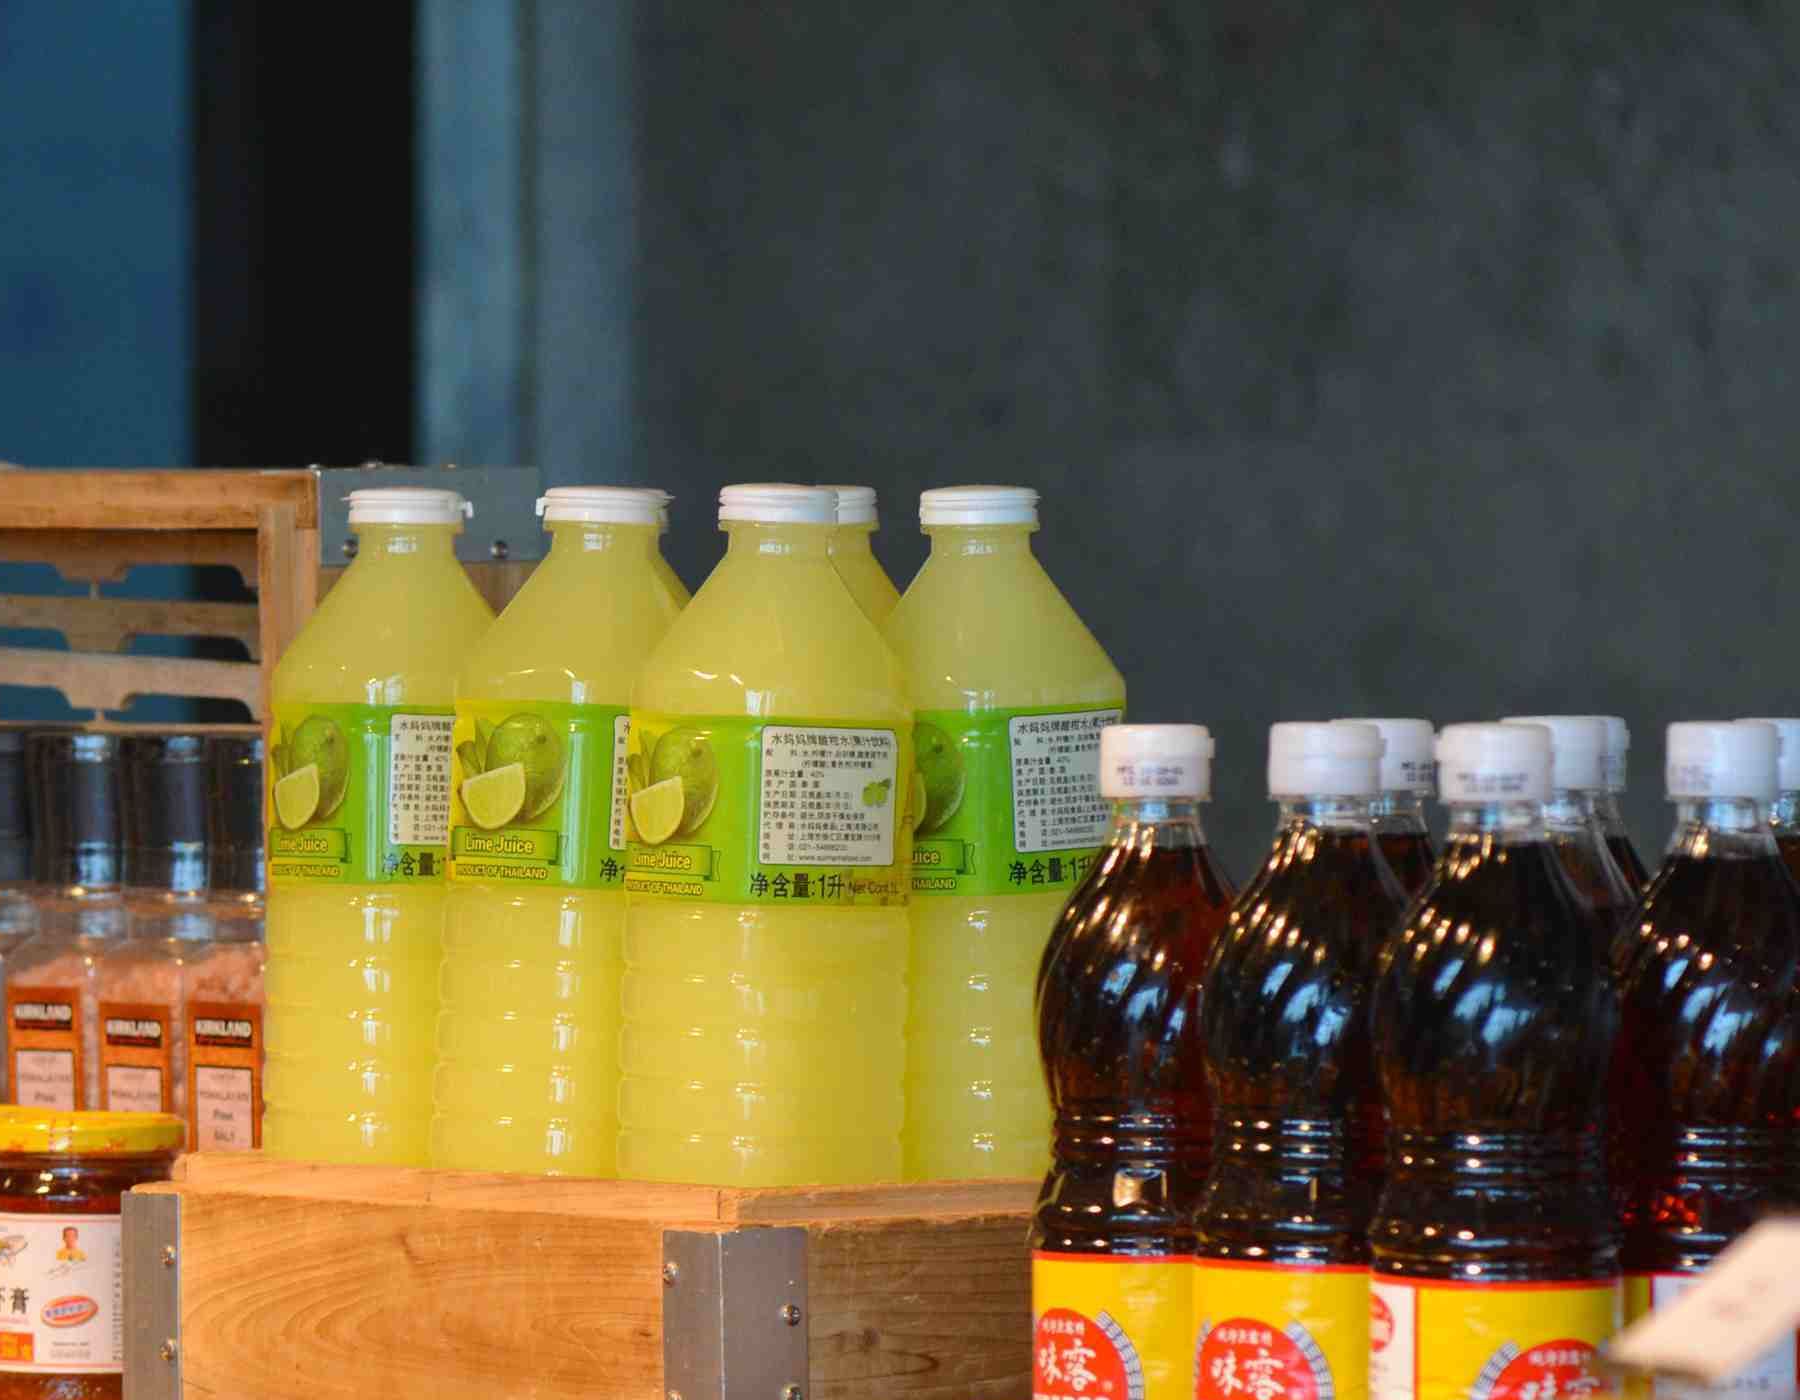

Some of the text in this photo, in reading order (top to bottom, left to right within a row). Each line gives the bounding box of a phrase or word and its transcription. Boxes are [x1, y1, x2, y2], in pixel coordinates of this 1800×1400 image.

[465, 834, 535, 854] Lime Juice
[659, 851, 692, 870] Juice
